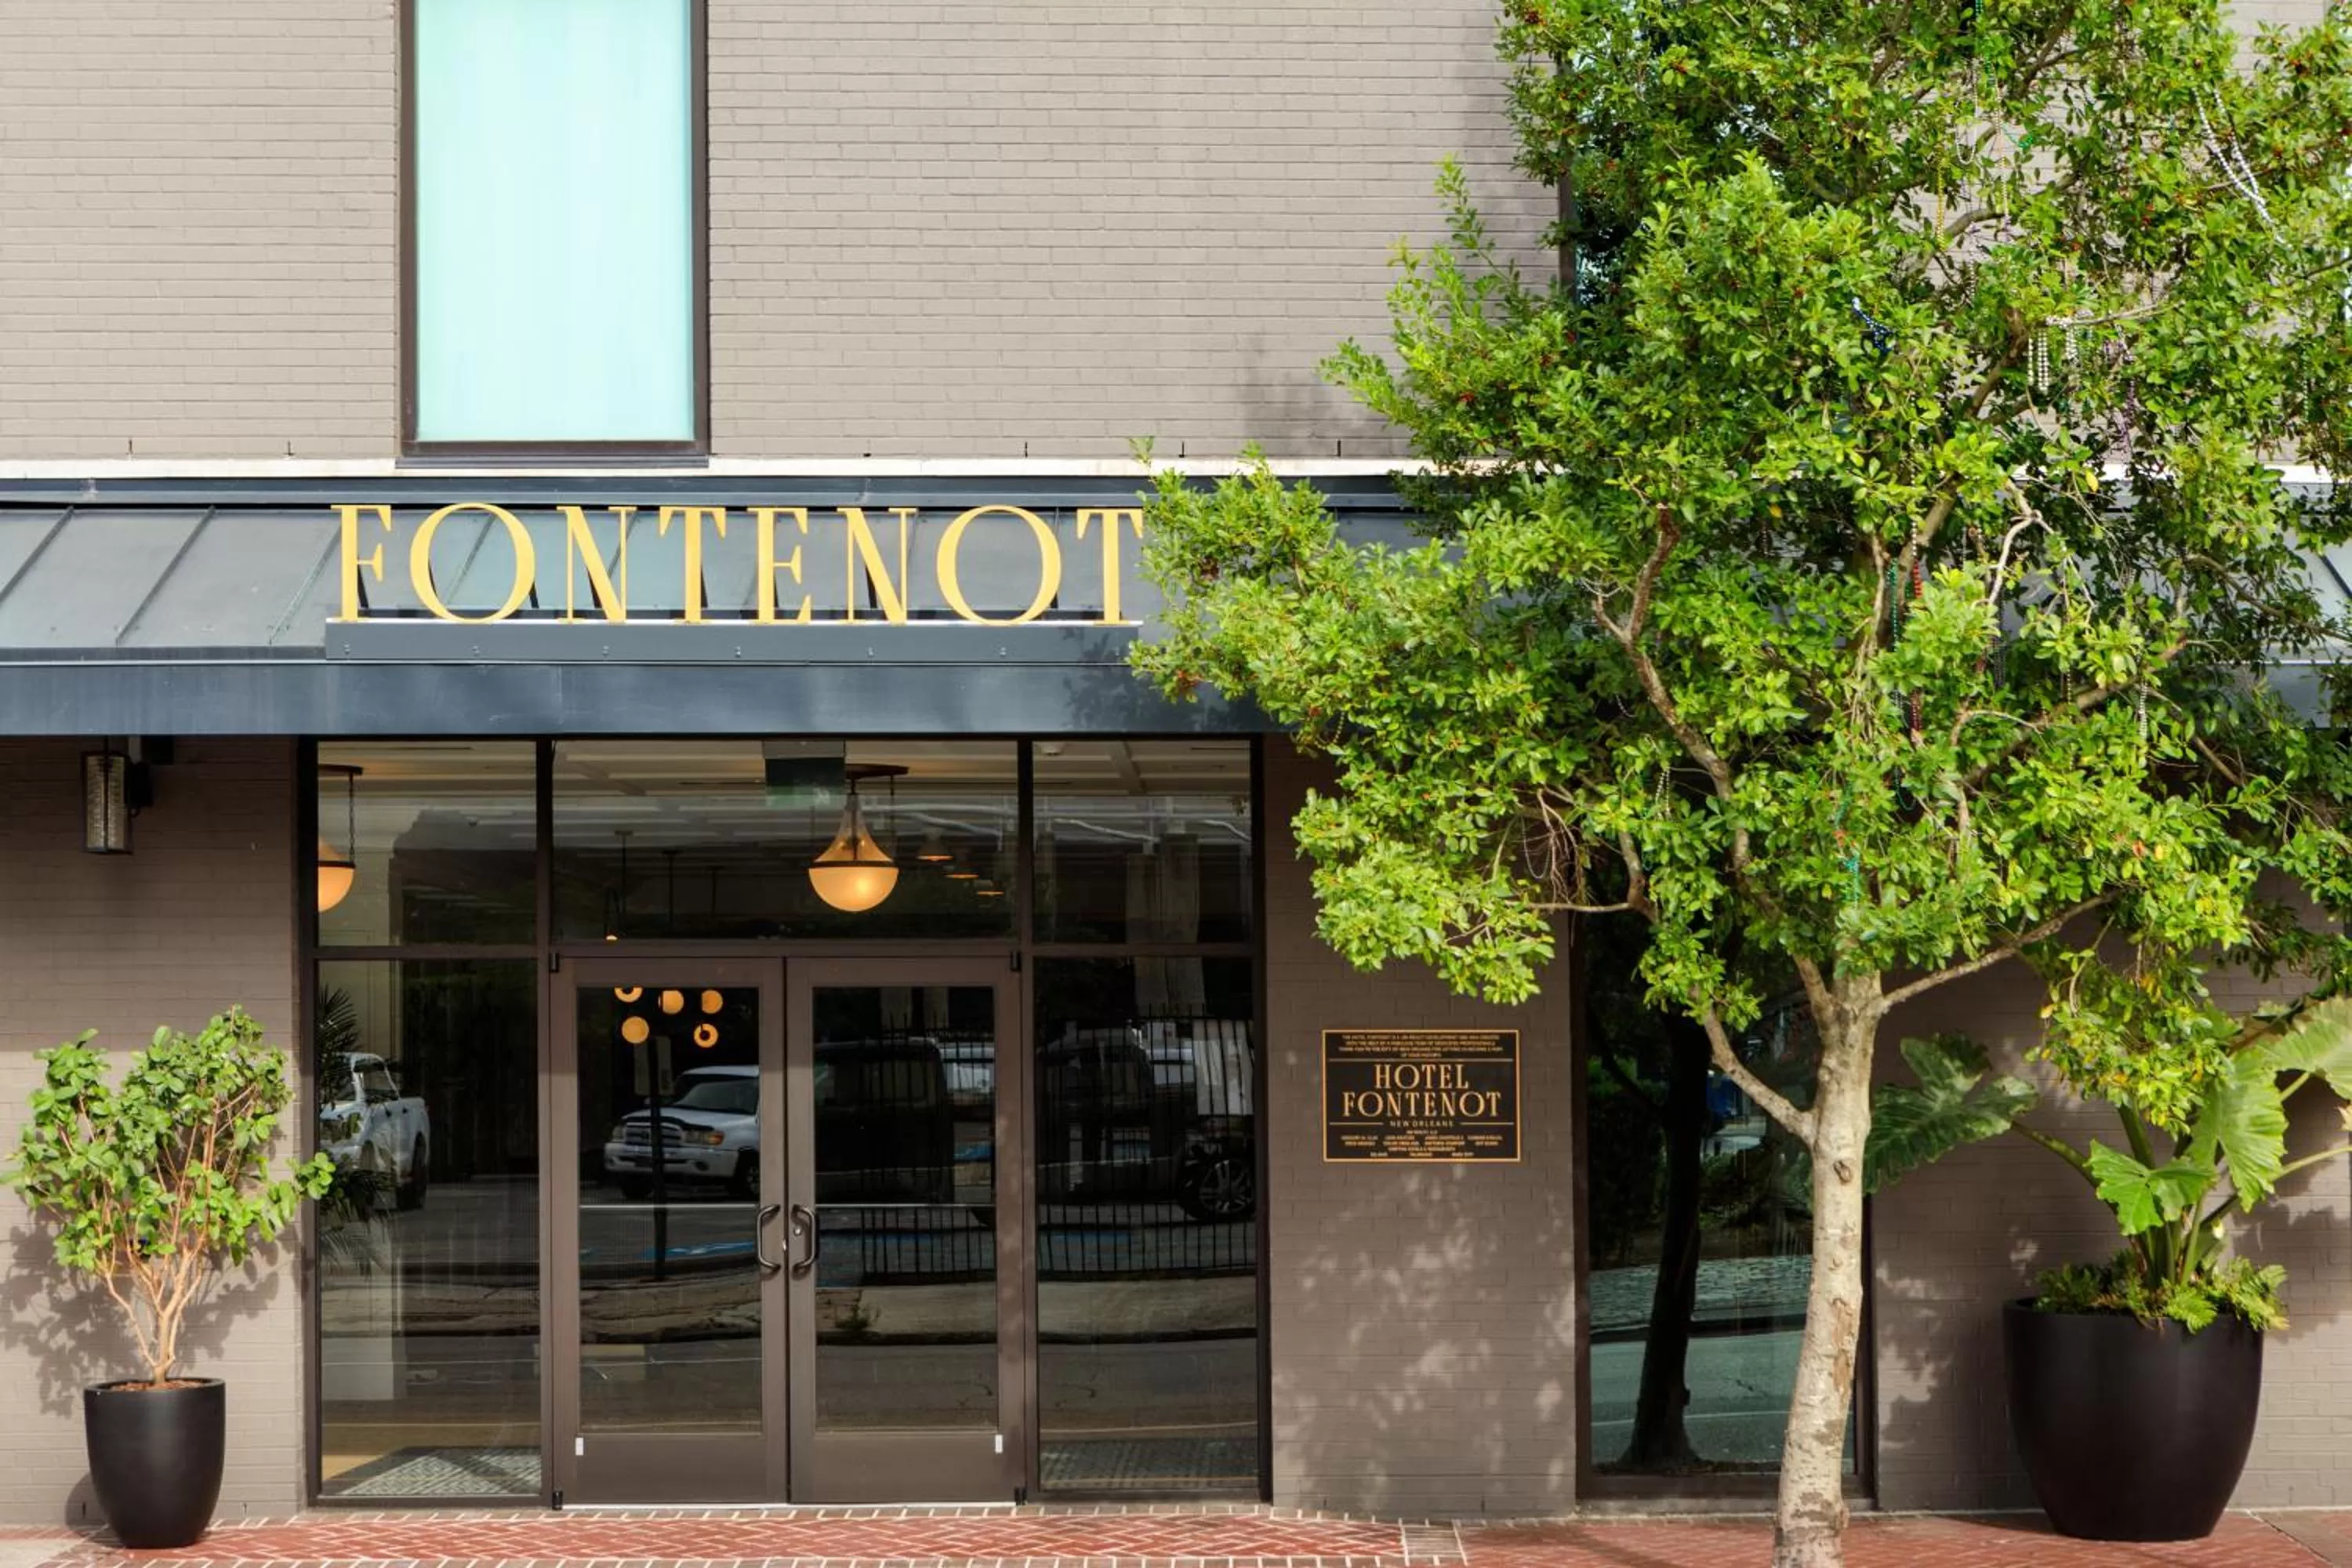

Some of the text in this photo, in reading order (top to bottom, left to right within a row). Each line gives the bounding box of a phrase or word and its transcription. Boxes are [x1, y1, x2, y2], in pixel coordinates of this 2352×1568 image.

[331, 503, 1144, 625] FONTENOT
[1374, 1064, 1469, 1089] HOTEL
[1343, 1091, 1501, 1117] FONTENOT
